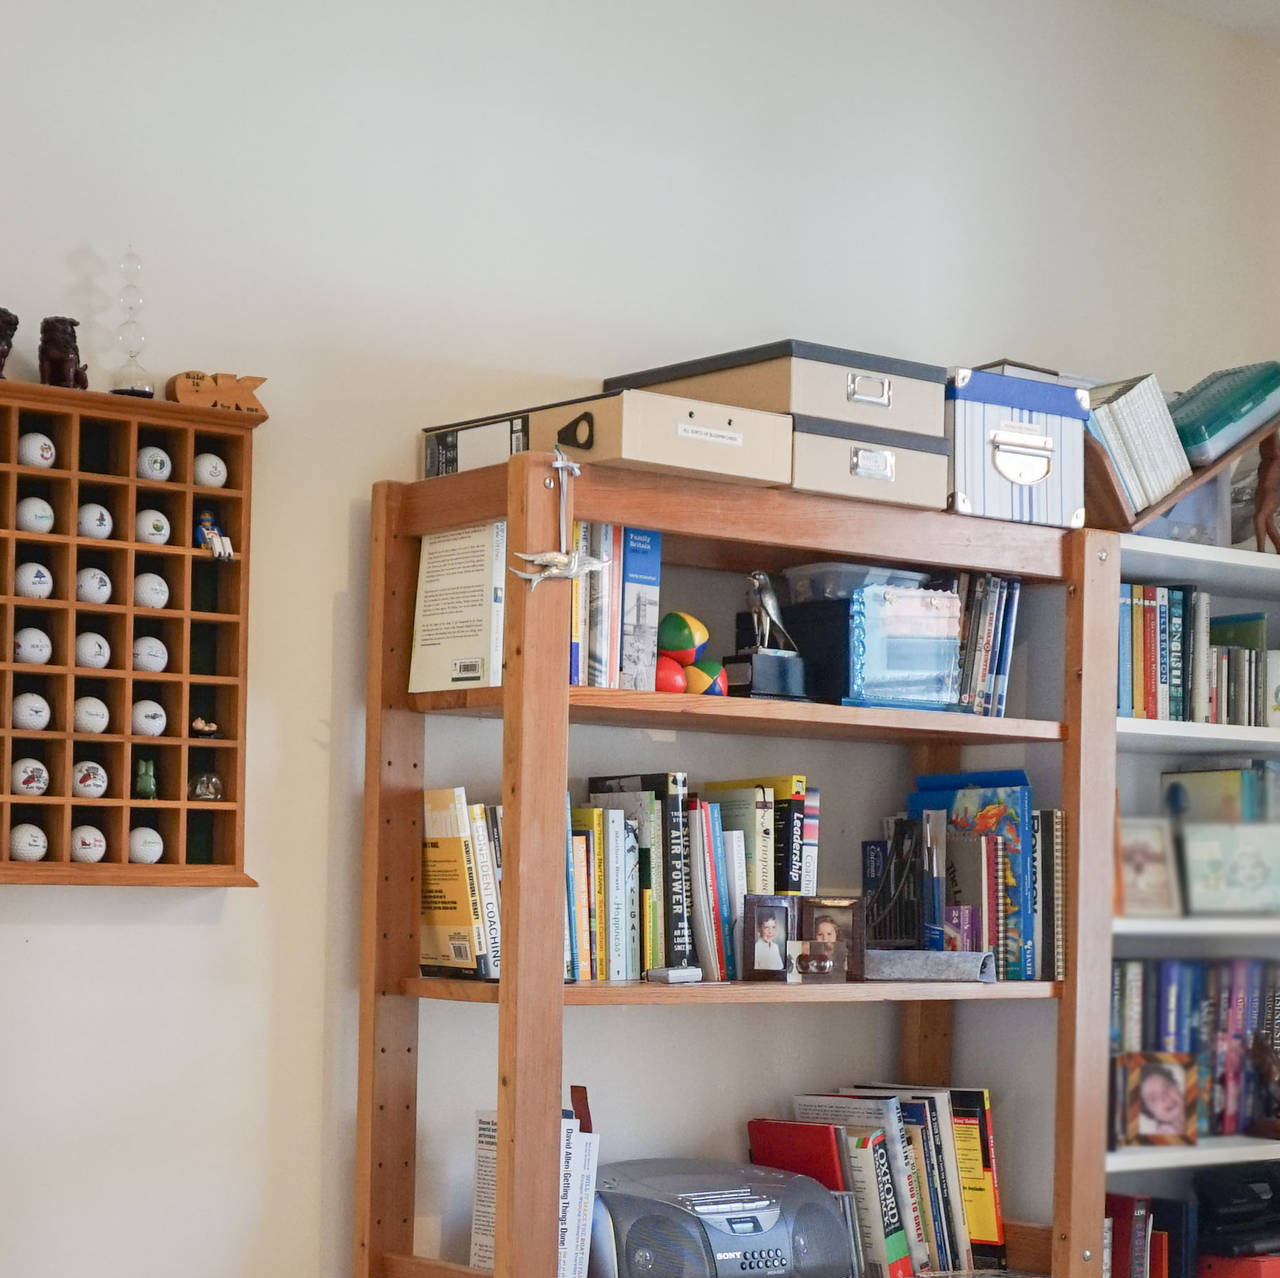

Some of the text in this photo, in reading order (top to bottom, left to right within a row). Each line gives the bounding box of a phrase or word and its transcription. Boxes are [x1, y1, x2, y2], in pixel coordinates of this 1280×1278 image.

[1160, 632, 1168, 684] BRYSON
[789, 812, 804, 881] Leadership
[597, 874, 605, 895] Living
[670, 829, 683, 914] AIR POWER
[803, 854, 814, 896] Coachin
[476, 821, 500, 967] CONFIDENT COACHING
[612, 902, 623, 953] Happiness
[564, 1128, 574, 1150] David
[563, 1151, 572, 1170] Allen
[895, 1105, 924, 1244] JIM COLLINS GOOD TO GREAT
[560, 1172, 572, 1200] Getting
[877, 1148, 899, 1226] OXFORD
[559, 1202, 570, 1226] Things
[559, 1227, 569, 1247] Done
[717, 1251, 742, 1260] SONY
